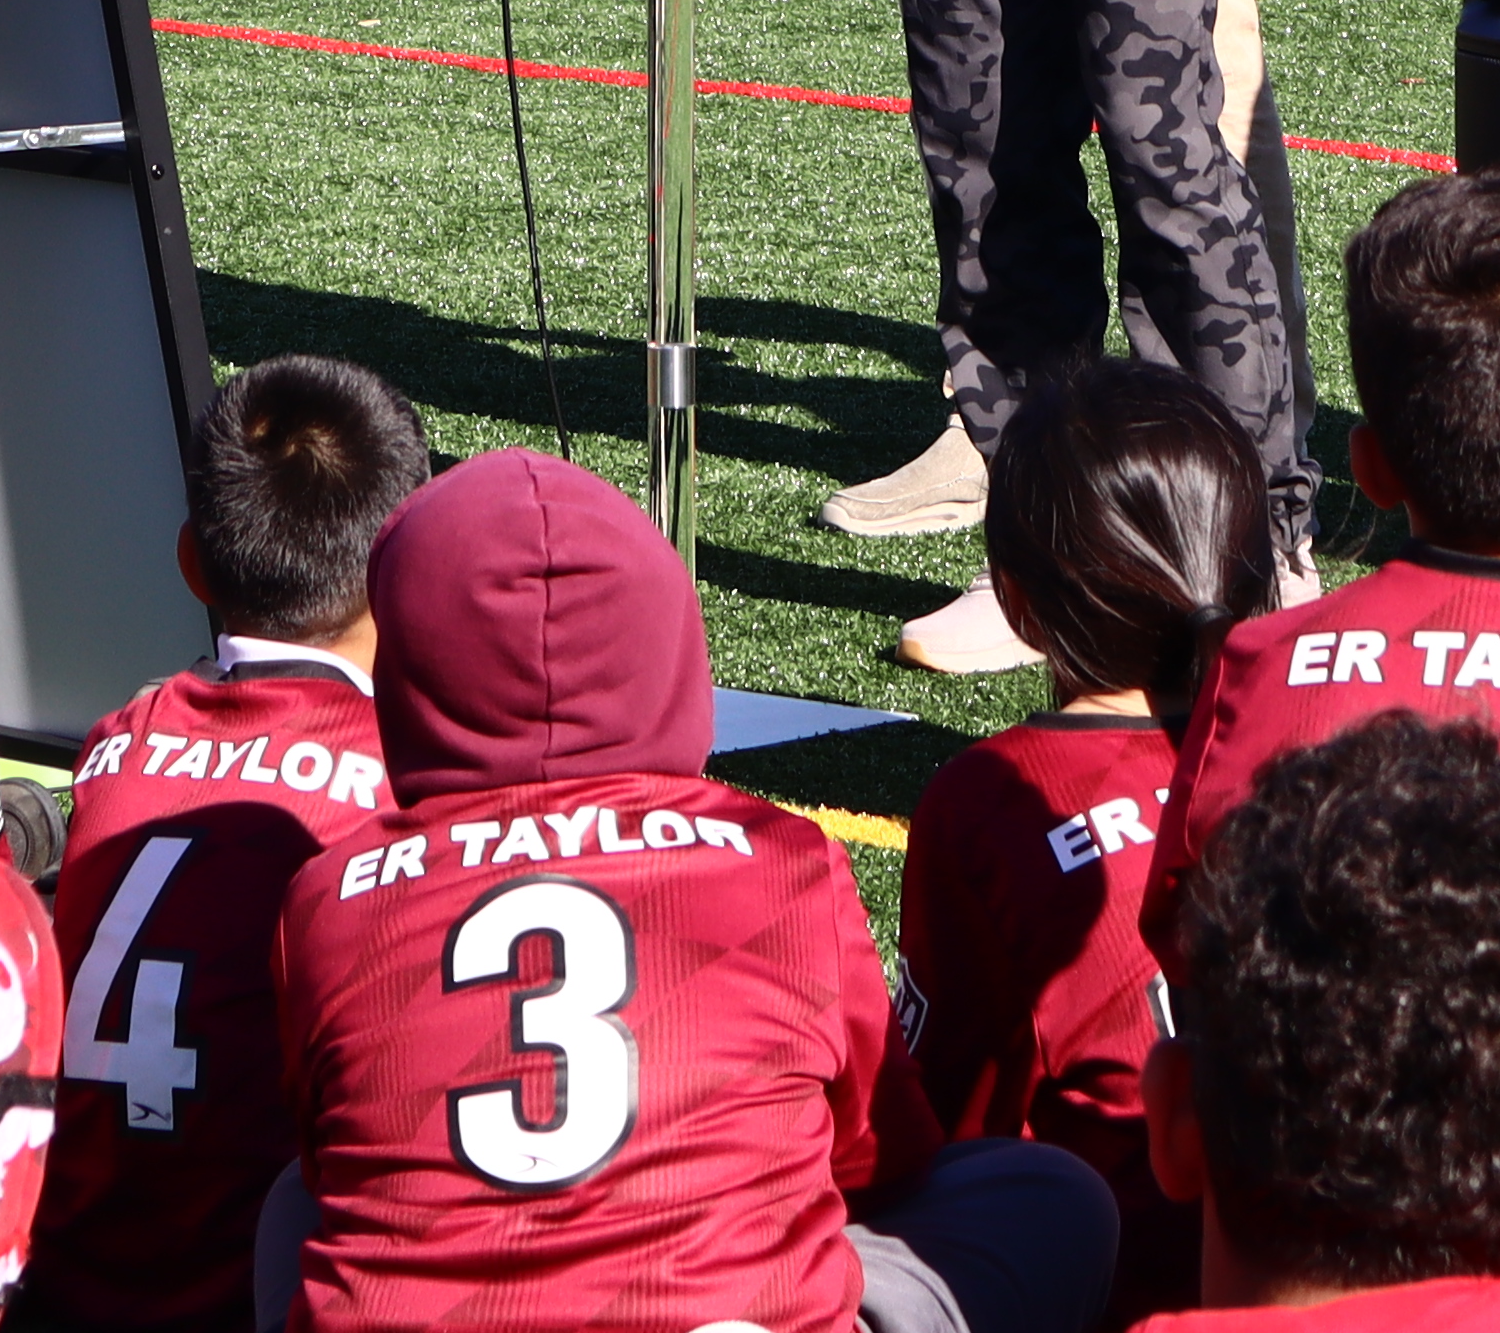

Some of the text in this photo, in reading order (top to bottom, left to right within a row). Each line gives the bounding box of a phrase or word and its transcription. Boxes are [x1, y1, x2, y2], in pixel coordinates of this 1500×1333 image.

[1286, 629, 1388, 687] ER
[74, 731, 386, 810] ER TAYLOR
[338, 804, 755, 902] ER TAYLOR
[1046, 796, 1157, 874] ER
[60, 833, 200, 1133] 4
[441, 872, 640, 1194] 3
